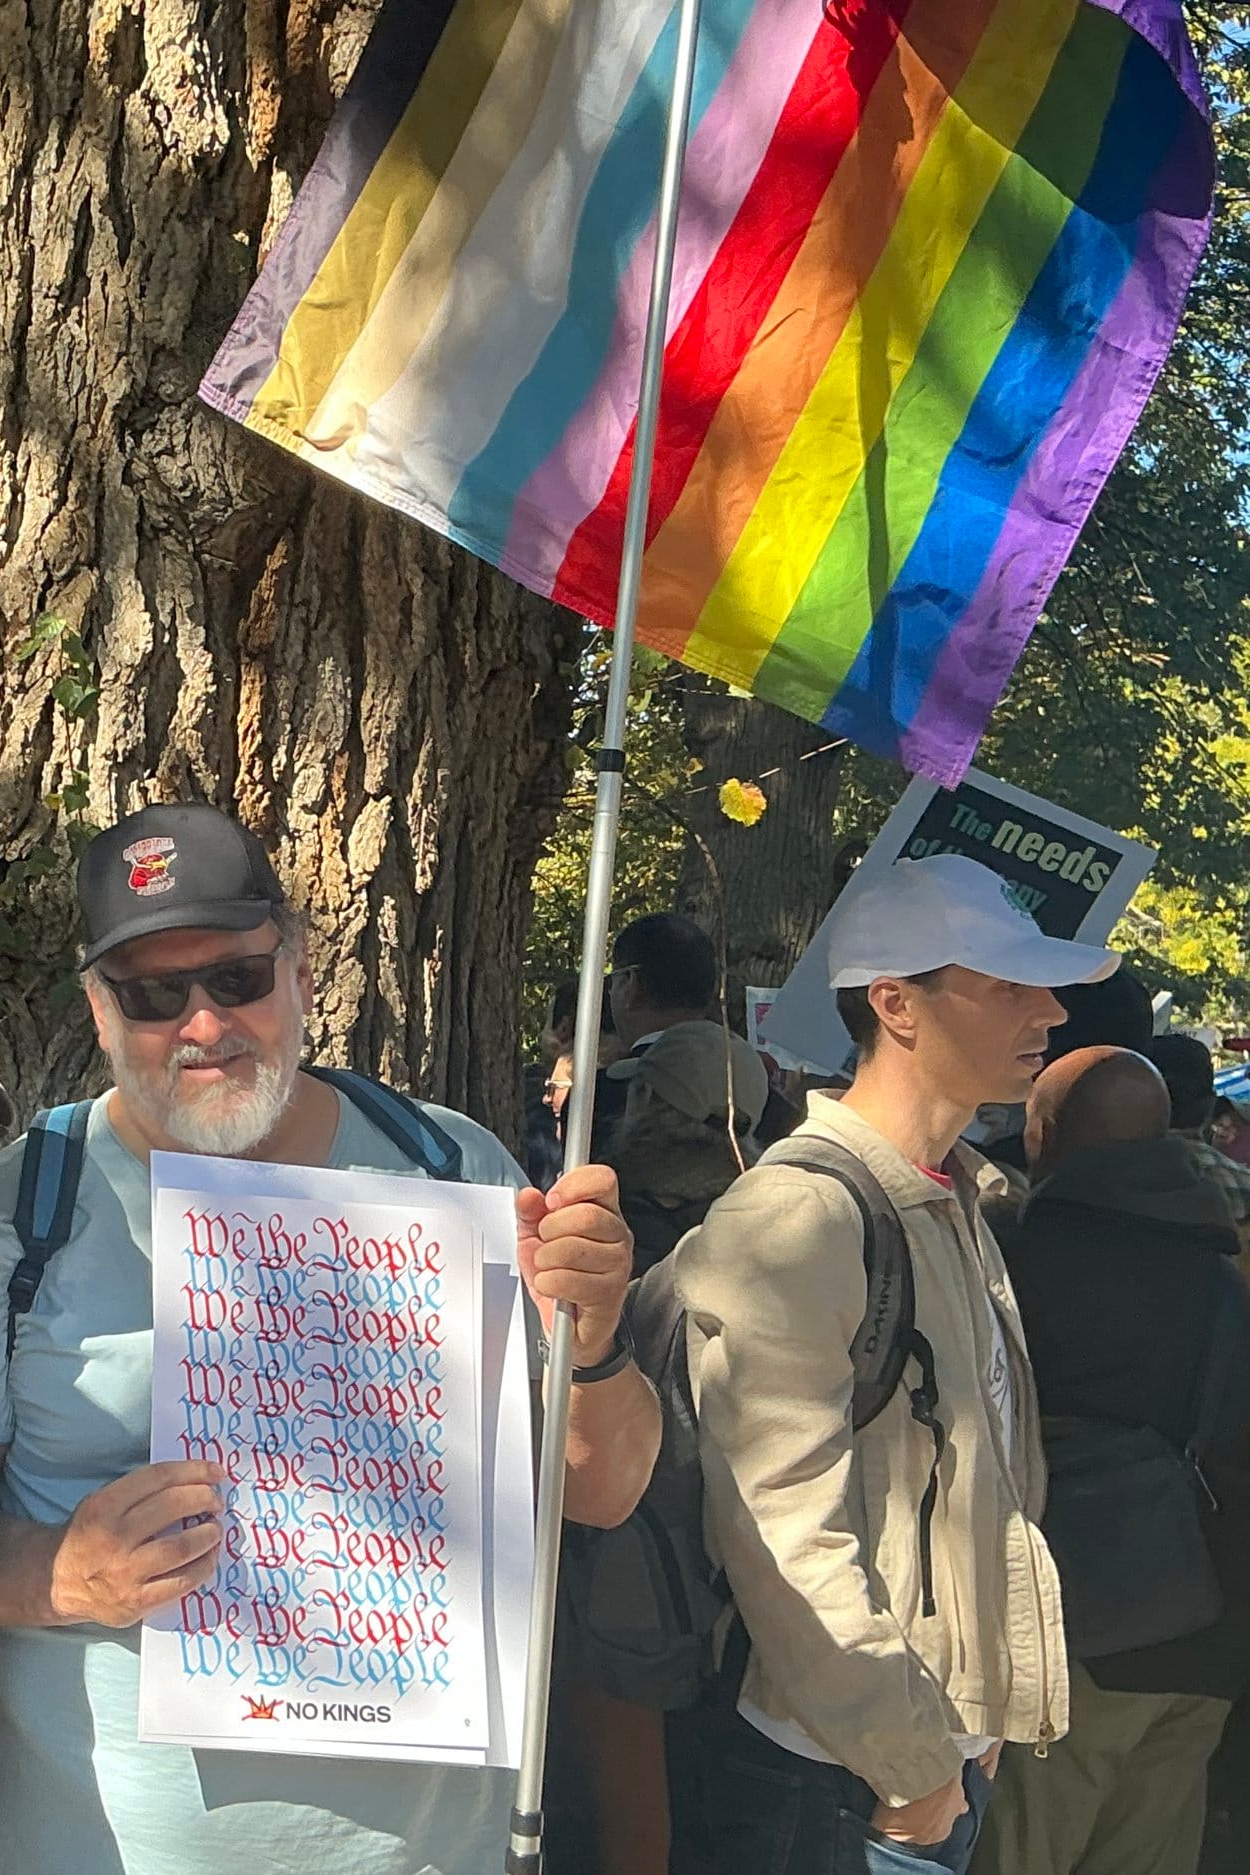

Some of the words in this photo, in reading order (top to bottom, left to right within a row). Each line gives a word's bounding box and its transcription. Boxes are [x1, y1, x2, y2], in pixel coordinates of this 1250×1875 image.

[950, 803, 994, 841] The
[990, 819, 1111, 893] needs
[306, 1216, 446, 1284] People
[305, 1288, 446, 1357] People
[304, 1362, 448, 1431] People
[304, 1435, 450, 1506] People
[305, 1511, 452, 1581] People
[306, 1588, 454, 1659] People
[285, 1702, 319, 1721] NO
[322, 1703, 392, 1723] KINGS
